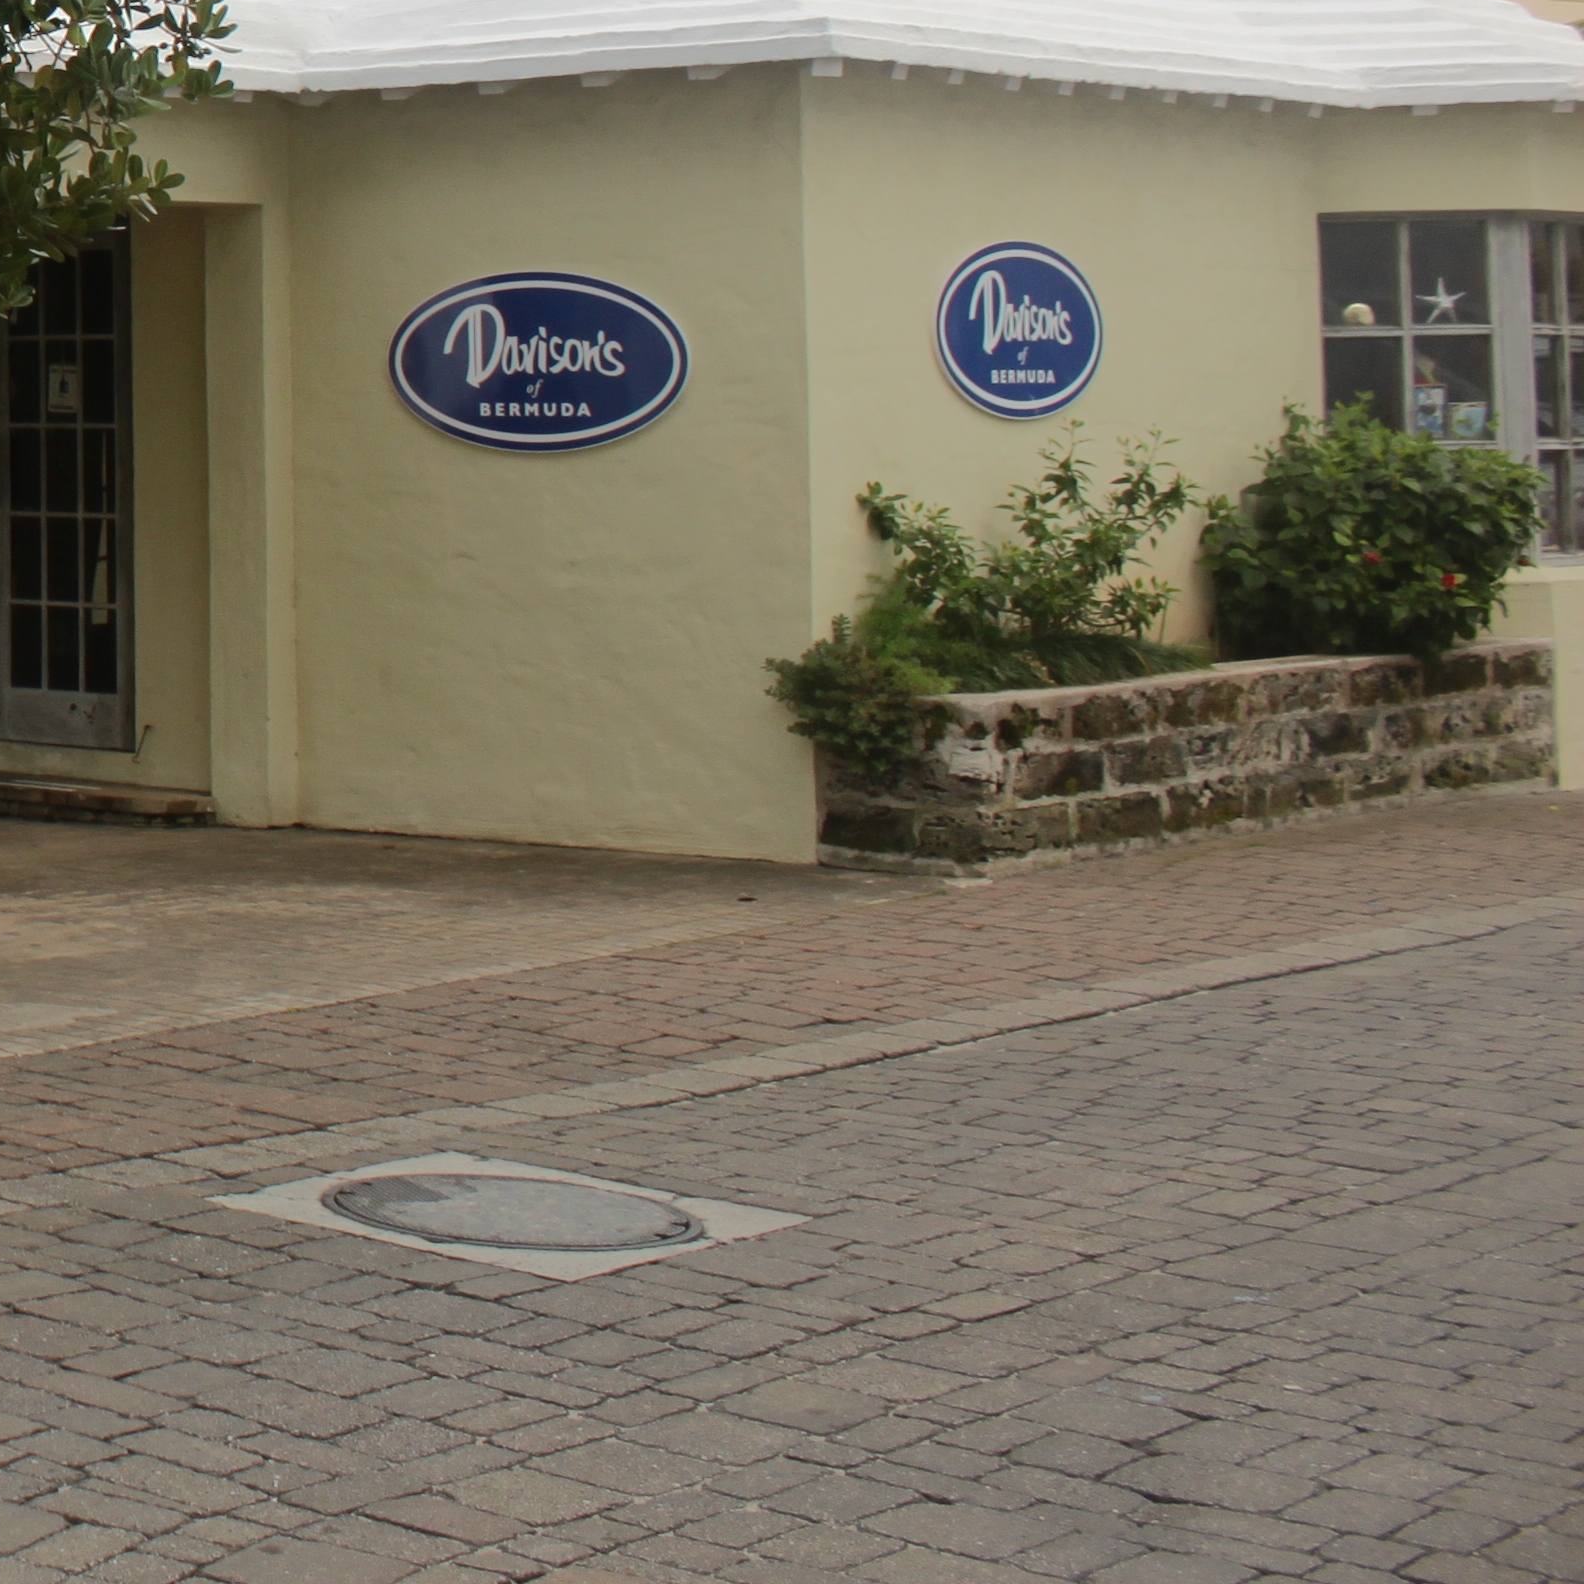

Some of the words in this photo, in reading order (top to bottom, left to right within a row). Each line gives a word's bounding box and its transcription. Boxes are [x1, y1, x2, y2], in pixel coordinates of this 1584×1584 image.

[968, 269, 1072, 354] Davison's
[443, 302, 624, 387] Davison's
[1017, 346, 1027, 365] of
[991, 370, 1055, 384] BERMUDA
[526, 378, 542, 397] of
[480, 402, 591, 417] BERMUDA
